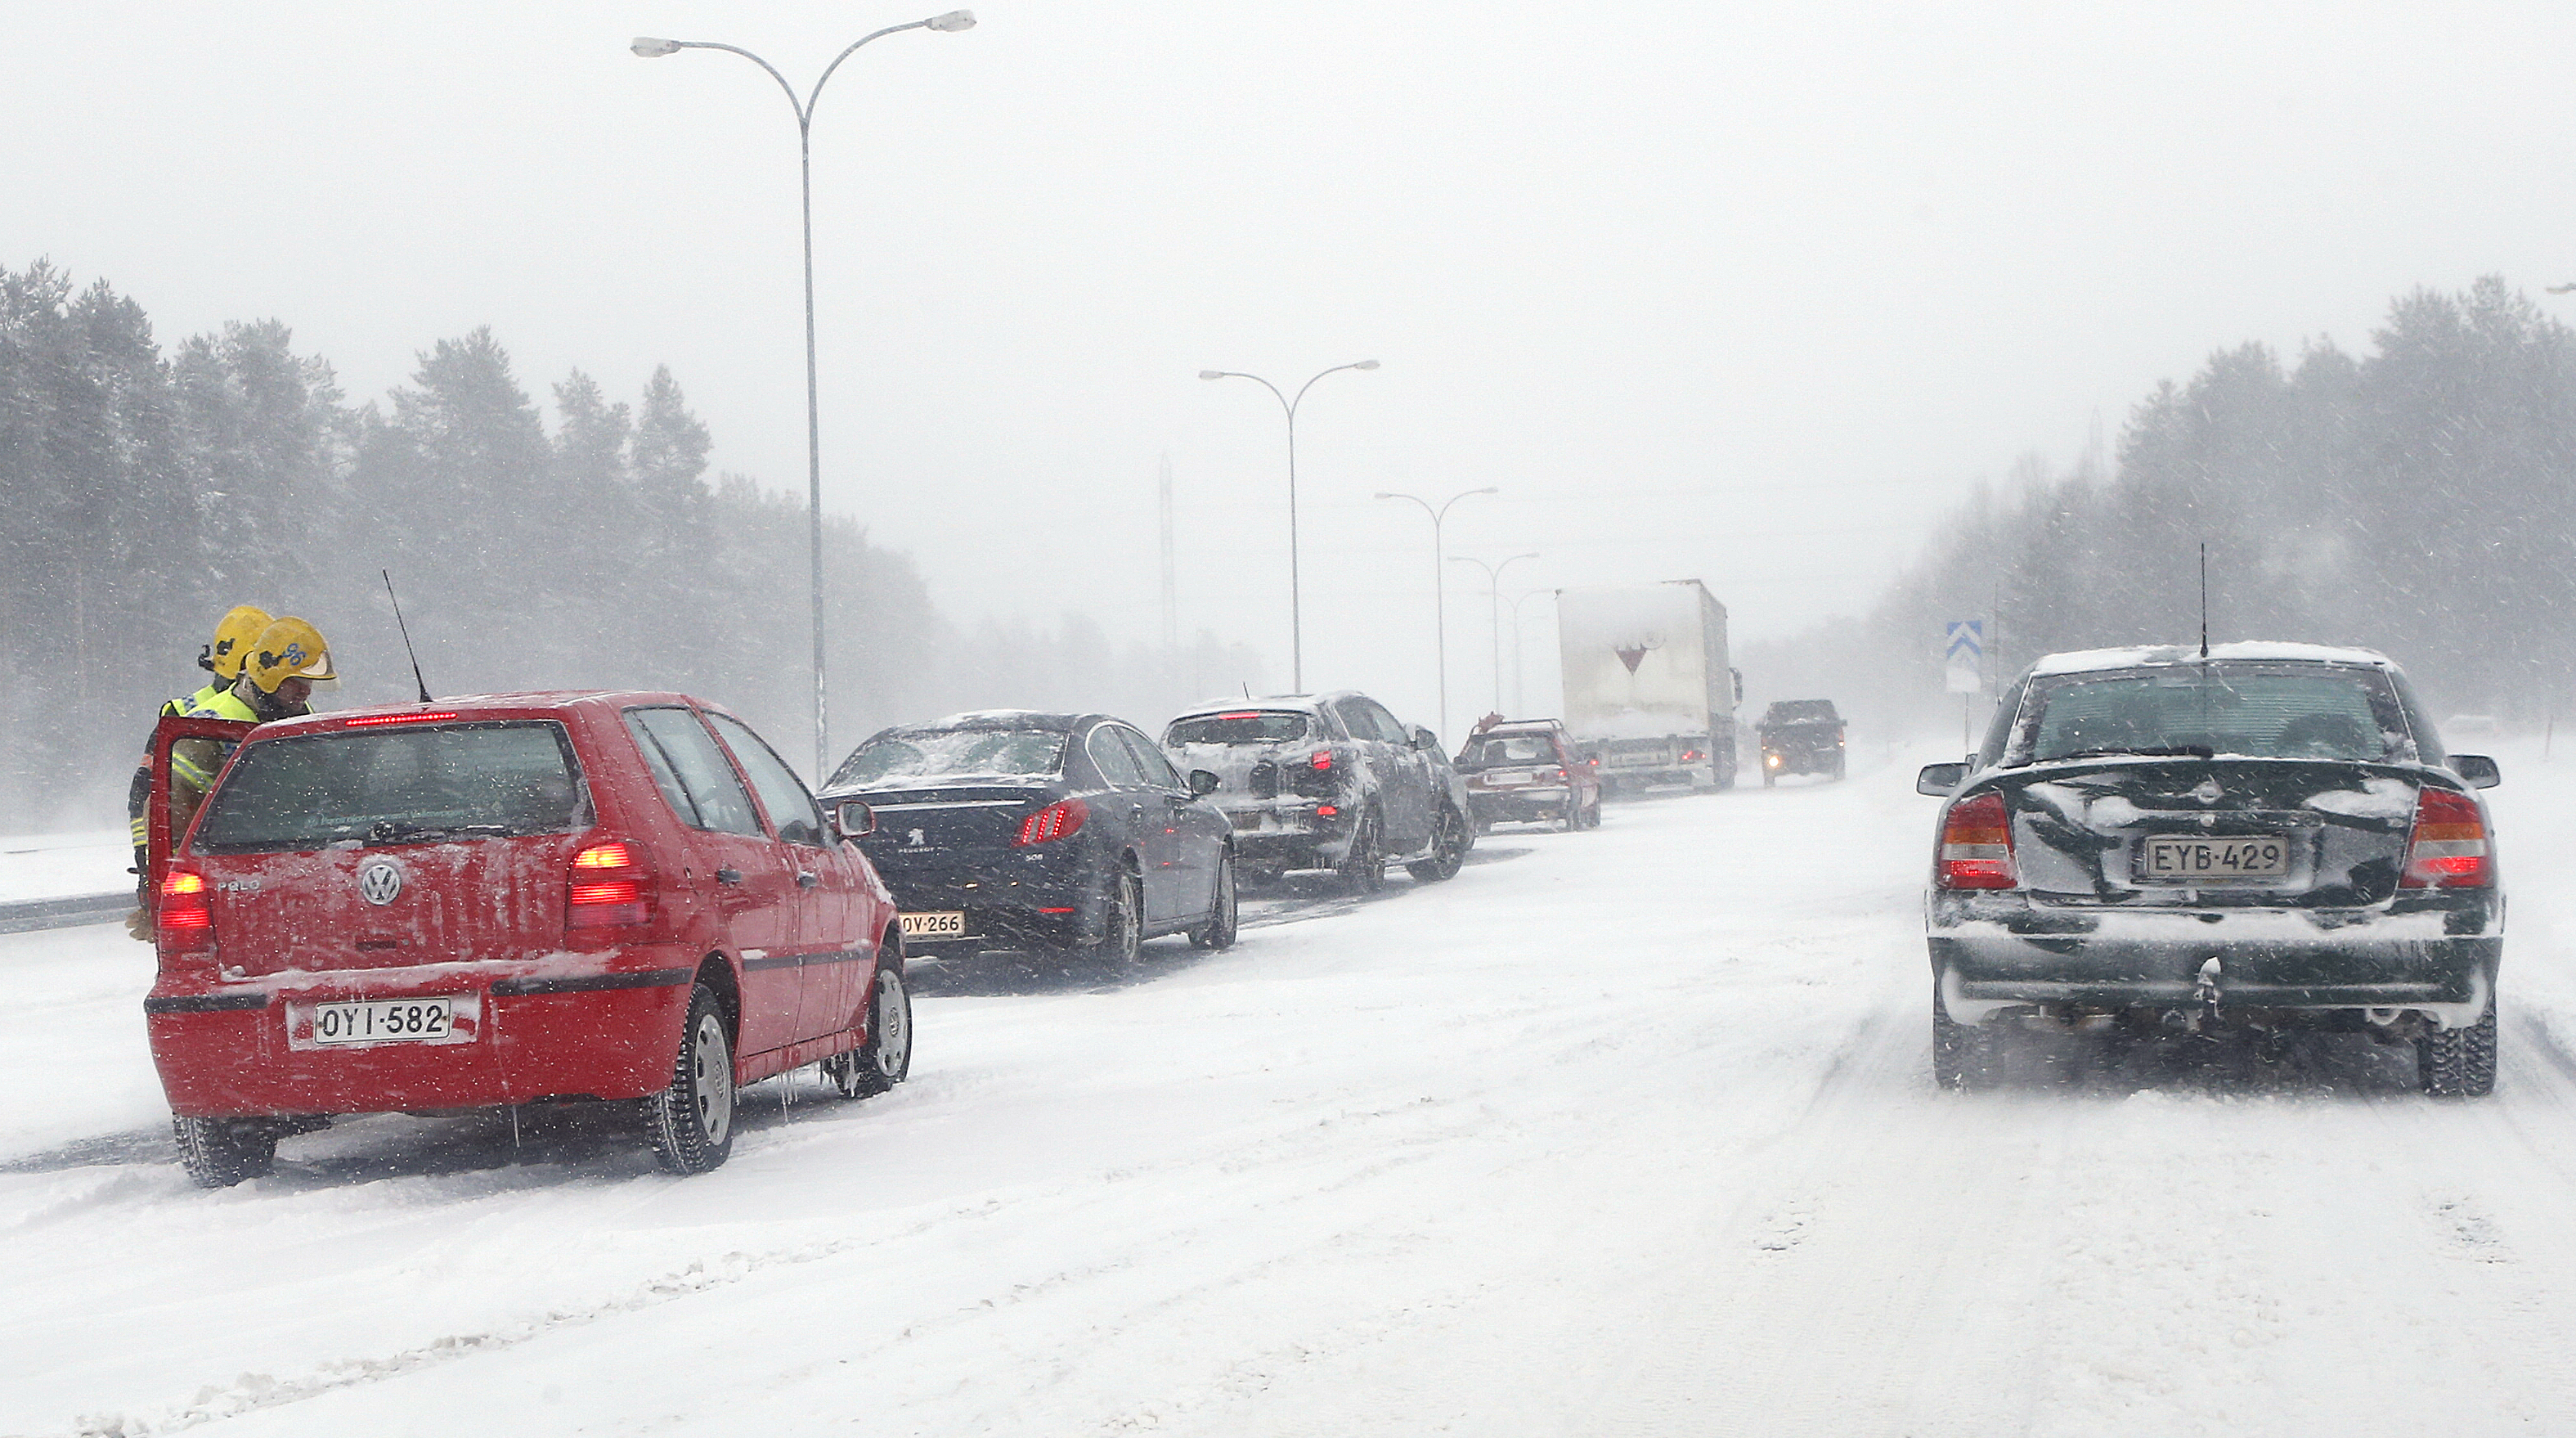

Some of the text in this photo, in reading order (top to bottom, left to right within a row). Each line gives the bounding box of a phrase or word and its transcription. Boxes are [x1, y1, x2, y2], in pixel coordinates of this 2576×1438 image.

[2155, 844, 2280, 870] EYB-429
[903, 915, 958, 932] OV-266
[322, 1004, 442, 1036] OYI-582
